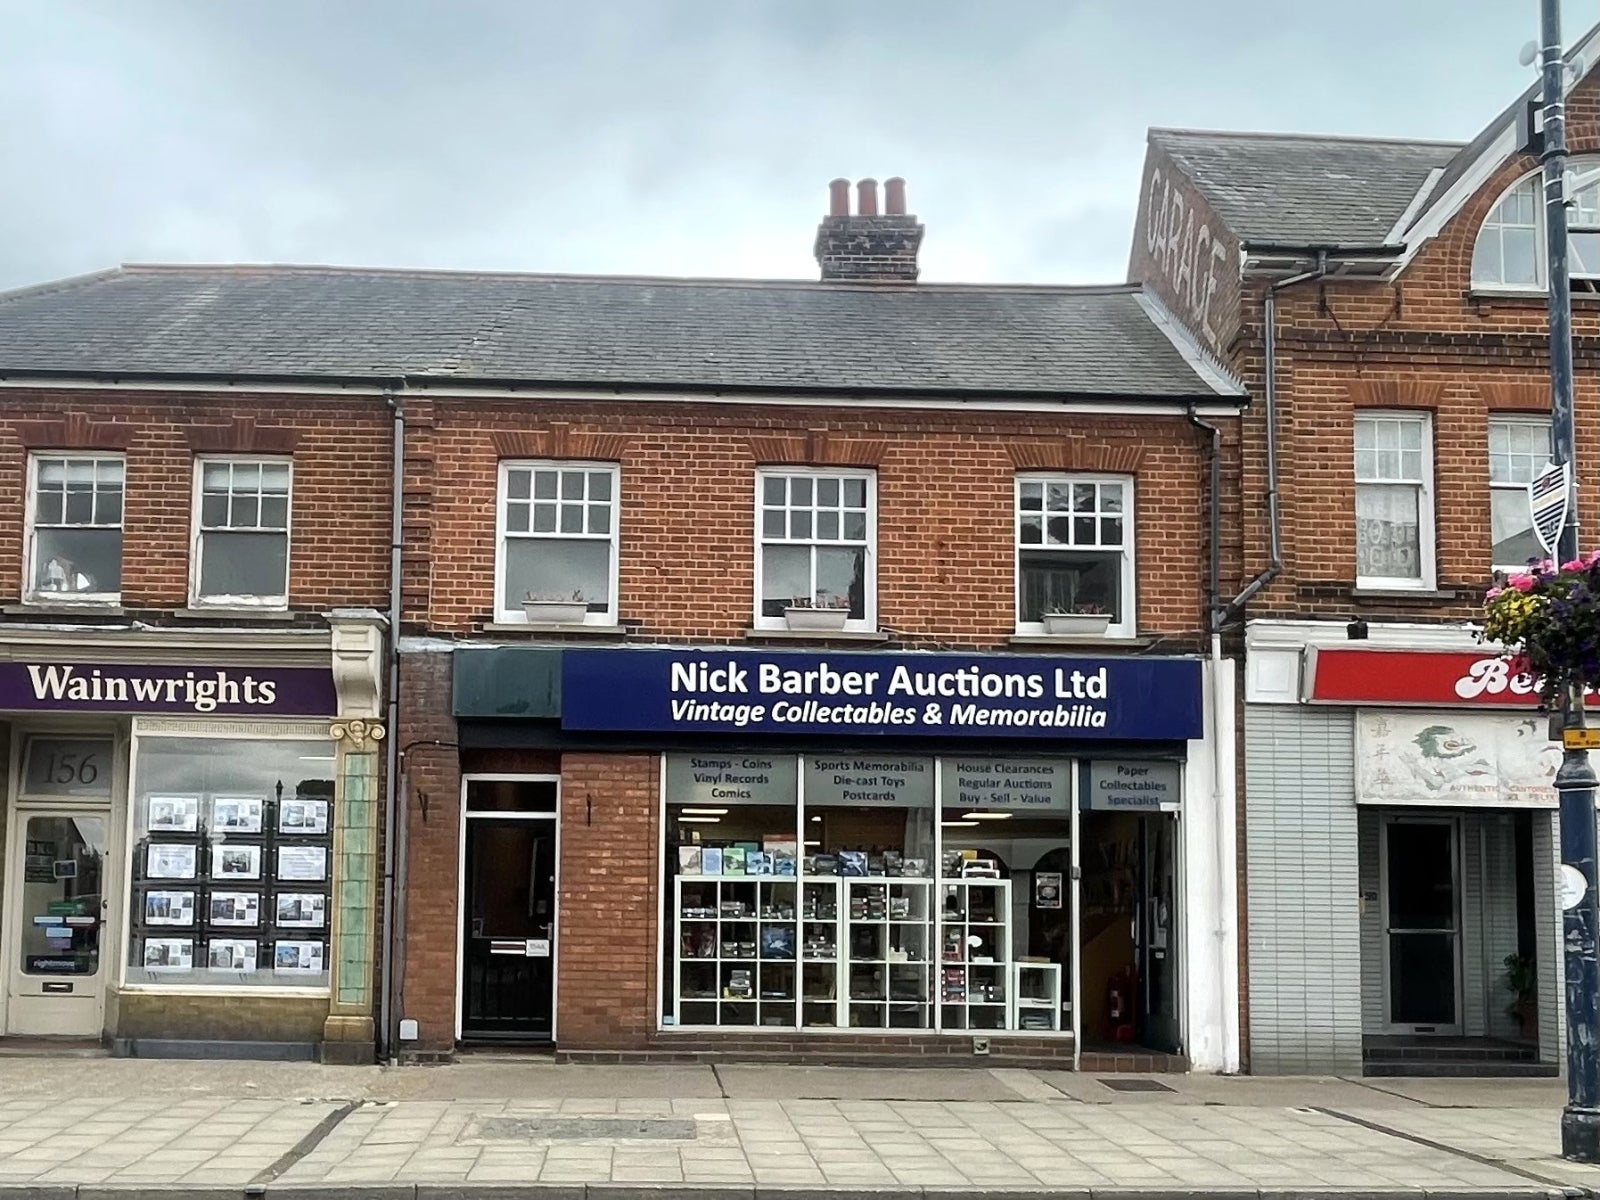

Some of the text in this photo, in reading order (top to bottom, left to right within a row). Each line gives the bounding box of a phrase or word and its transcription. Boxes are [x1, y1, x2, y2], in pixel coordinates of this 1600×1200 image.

[670, 661, 1107, 699] Nick Barber Auctions Ltd
[26, 664, 276, 712] Wainwrights
[670, 699, 1107, 728] Vintage Collectables & Memorabilia
[43, 752, 98, 785] 156
[690, 758, 732, 770] Stamps
[742, 758, 772, 769] Coins
[814, 760, 924, 773] Sports Memorabilia
[956, 763, 1054, 775] House Clearances
[1117, 765, 1150, 777] Paper
[693, 773, 769, 785] Vinyl Records
[833, 775, 905, 788] Die-cast Toys
[958, 777, 1052, 790] Regular Auctions
[1099, 779, 1167, 791] Collectables
[711, 787, 751, 799] Comics
[842, 790, 896, 801] Postcards
[959, 792, 980, 804] Buy
[990, 793, 1010, 803] Sell
[1020, 793, 1052, 804] Value
[1107, 795, 1160, 806] Specialist
